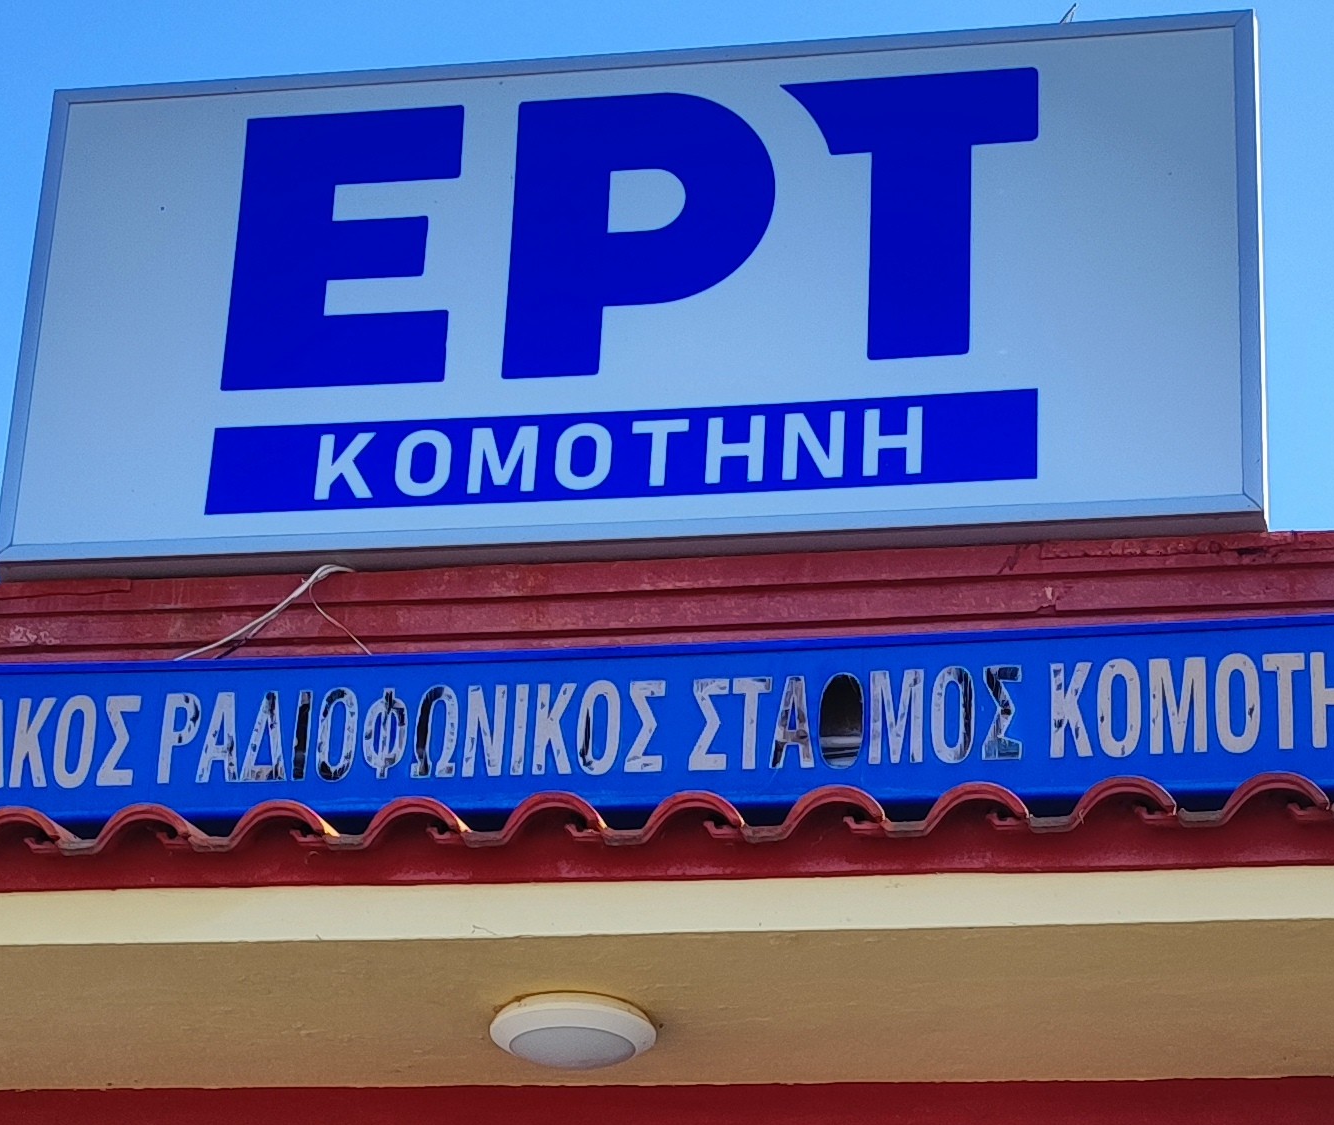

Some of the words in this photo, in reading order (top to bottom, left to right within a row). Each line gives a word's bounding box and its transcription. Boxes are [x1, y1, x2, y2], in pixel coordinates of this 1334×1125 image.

[219, 67, 1040, 392] ΕΡΤ
[313, 407, 925, 501] ΚΟΜΟΤΗΝΗ
[156, 680, 667, 784] ΡΑΔΙΟΦΩΝΙΚΟΣ
